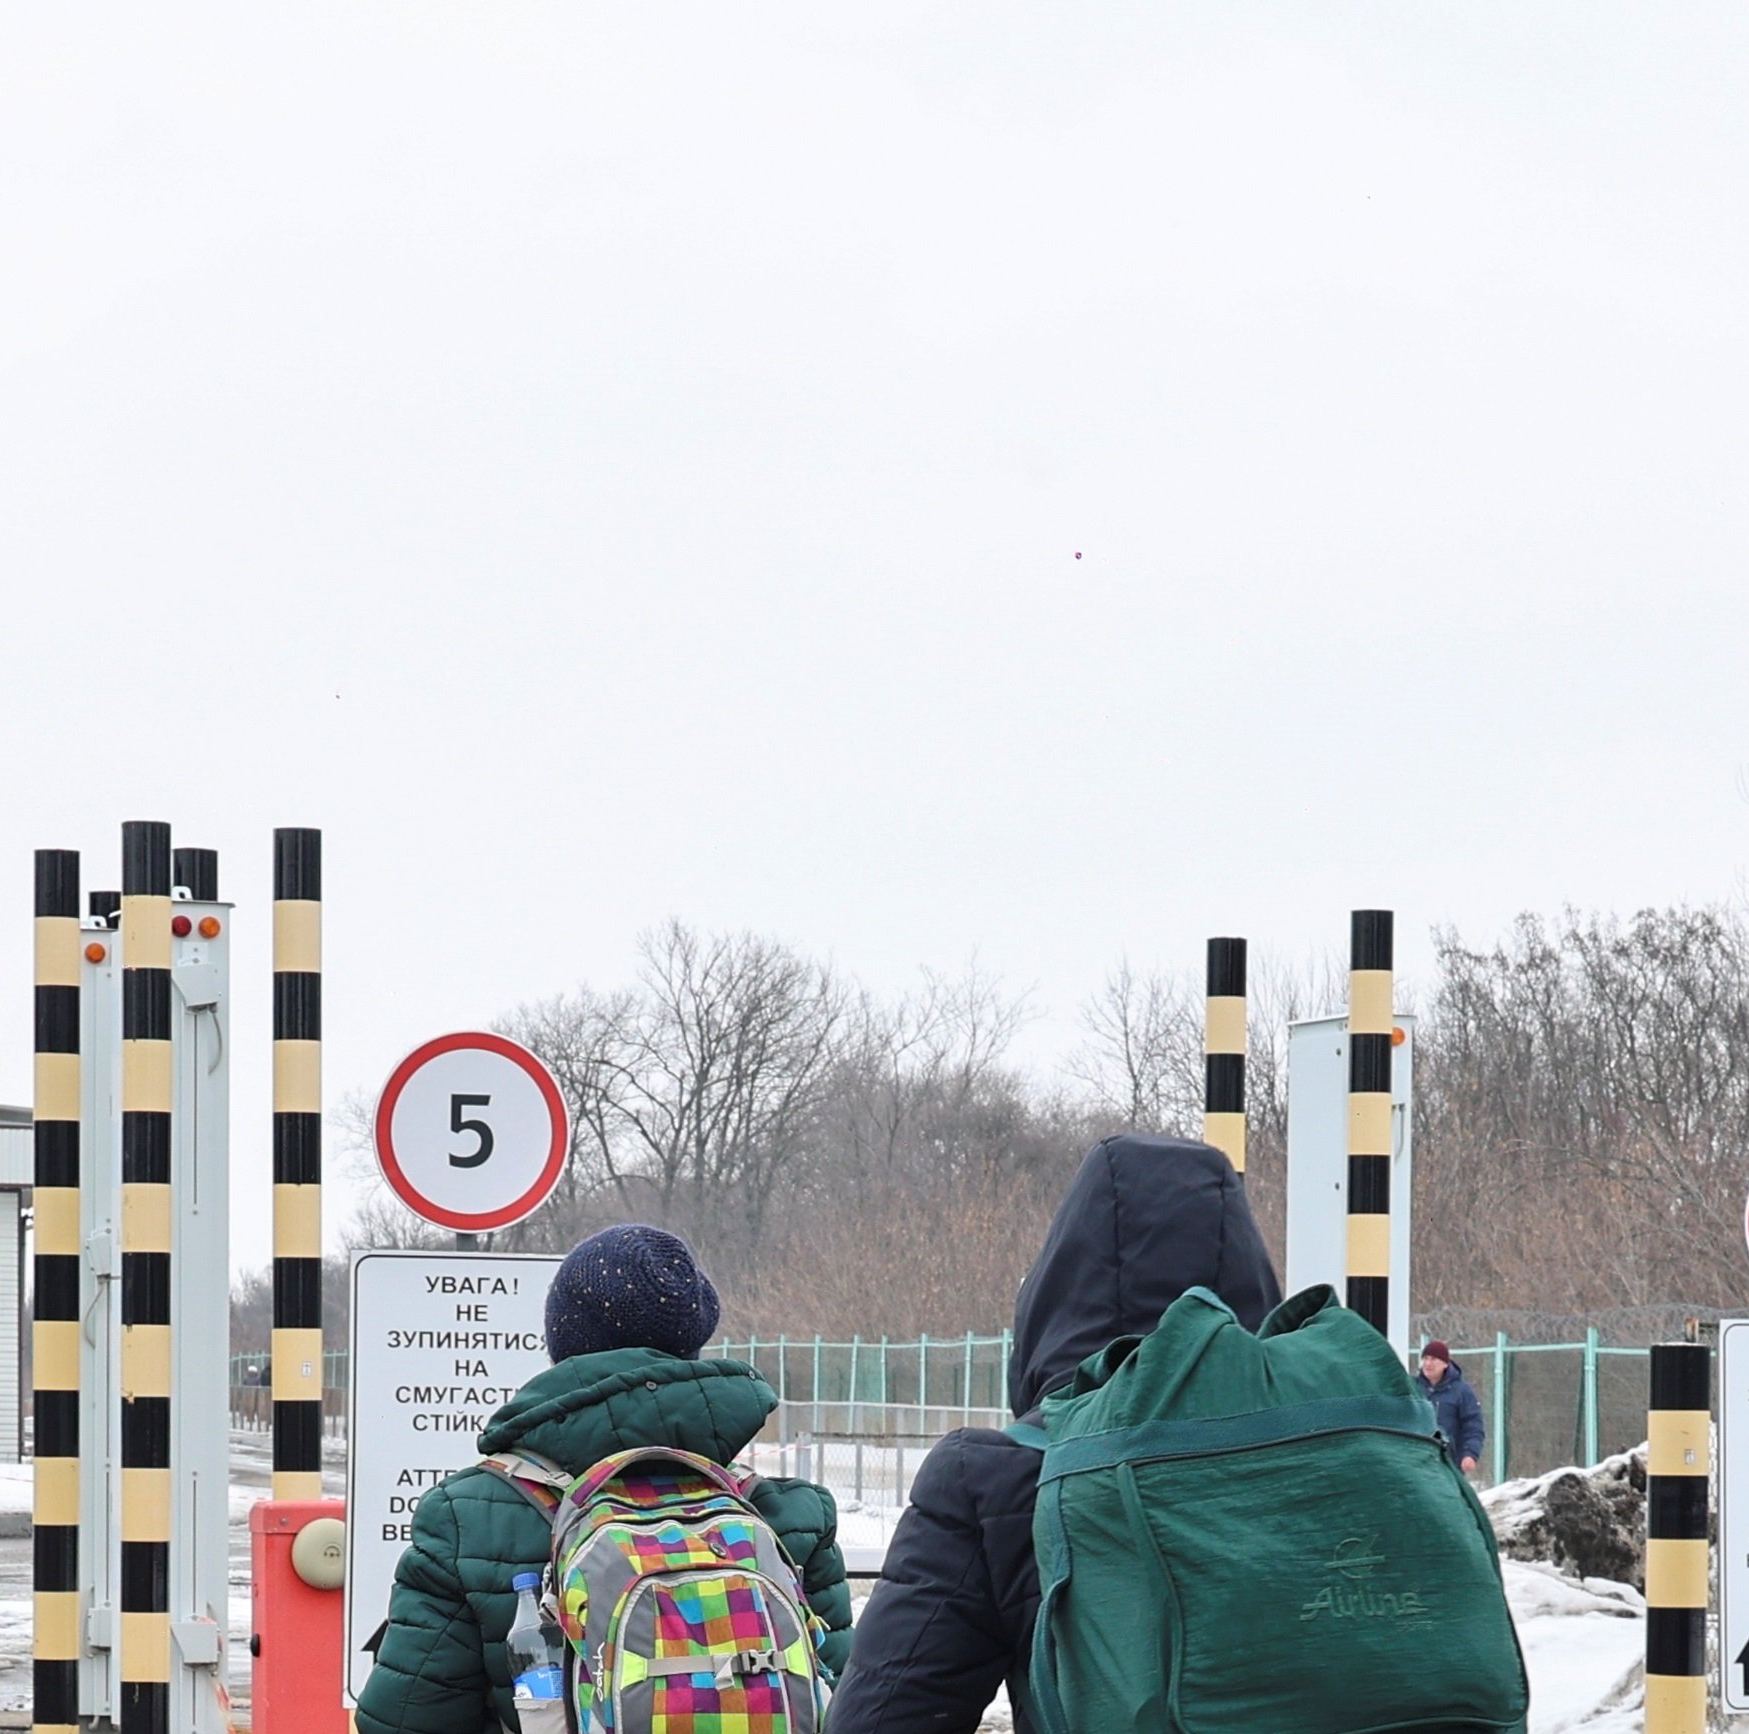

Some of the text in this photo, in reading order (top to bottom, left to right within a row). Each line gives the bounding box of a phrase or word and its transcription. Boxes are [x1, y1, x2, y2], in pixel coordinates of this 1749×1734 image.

[448, 1093, 494, 1169] 5
[456, 1304, 488, 1322] НЕ
[455, 1359, 489, 1377] НА
[395, 1385, 519, 1405] СМУГАСТ
[412, 1410, 486, 1432] СТІЙК
